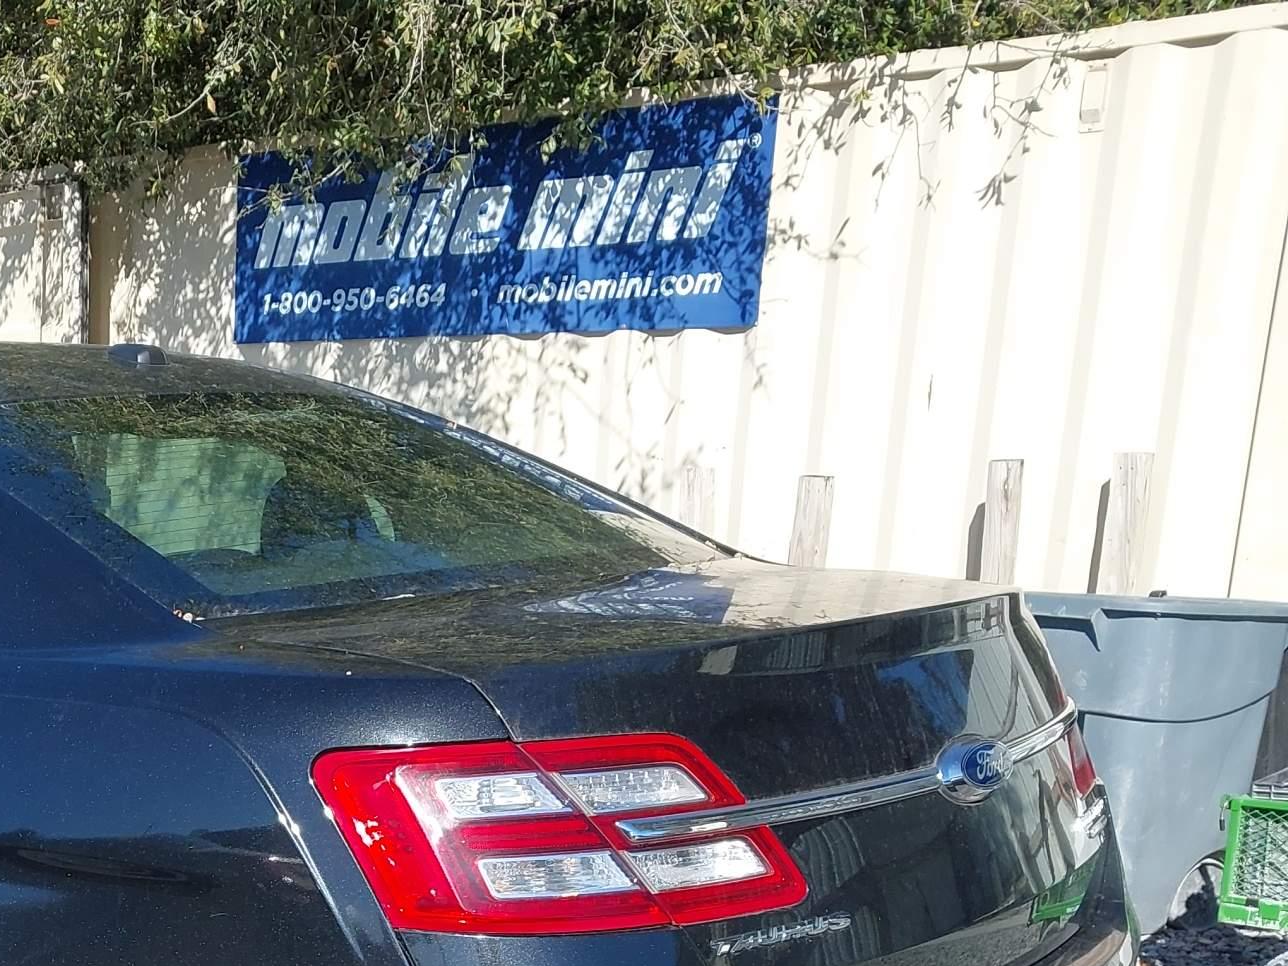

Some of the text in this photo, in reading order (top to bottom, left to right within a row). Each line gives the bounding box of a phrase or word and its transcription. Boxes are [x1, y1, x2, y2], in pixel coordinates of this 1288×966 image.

[254, 155, 512, 269] mobile
[263, 271, 724, 315] 1-800-950-6464 mobilemini.com
[976, 750, 1007, 780] Ford
[710, 911, 852, 956] TAURUS
